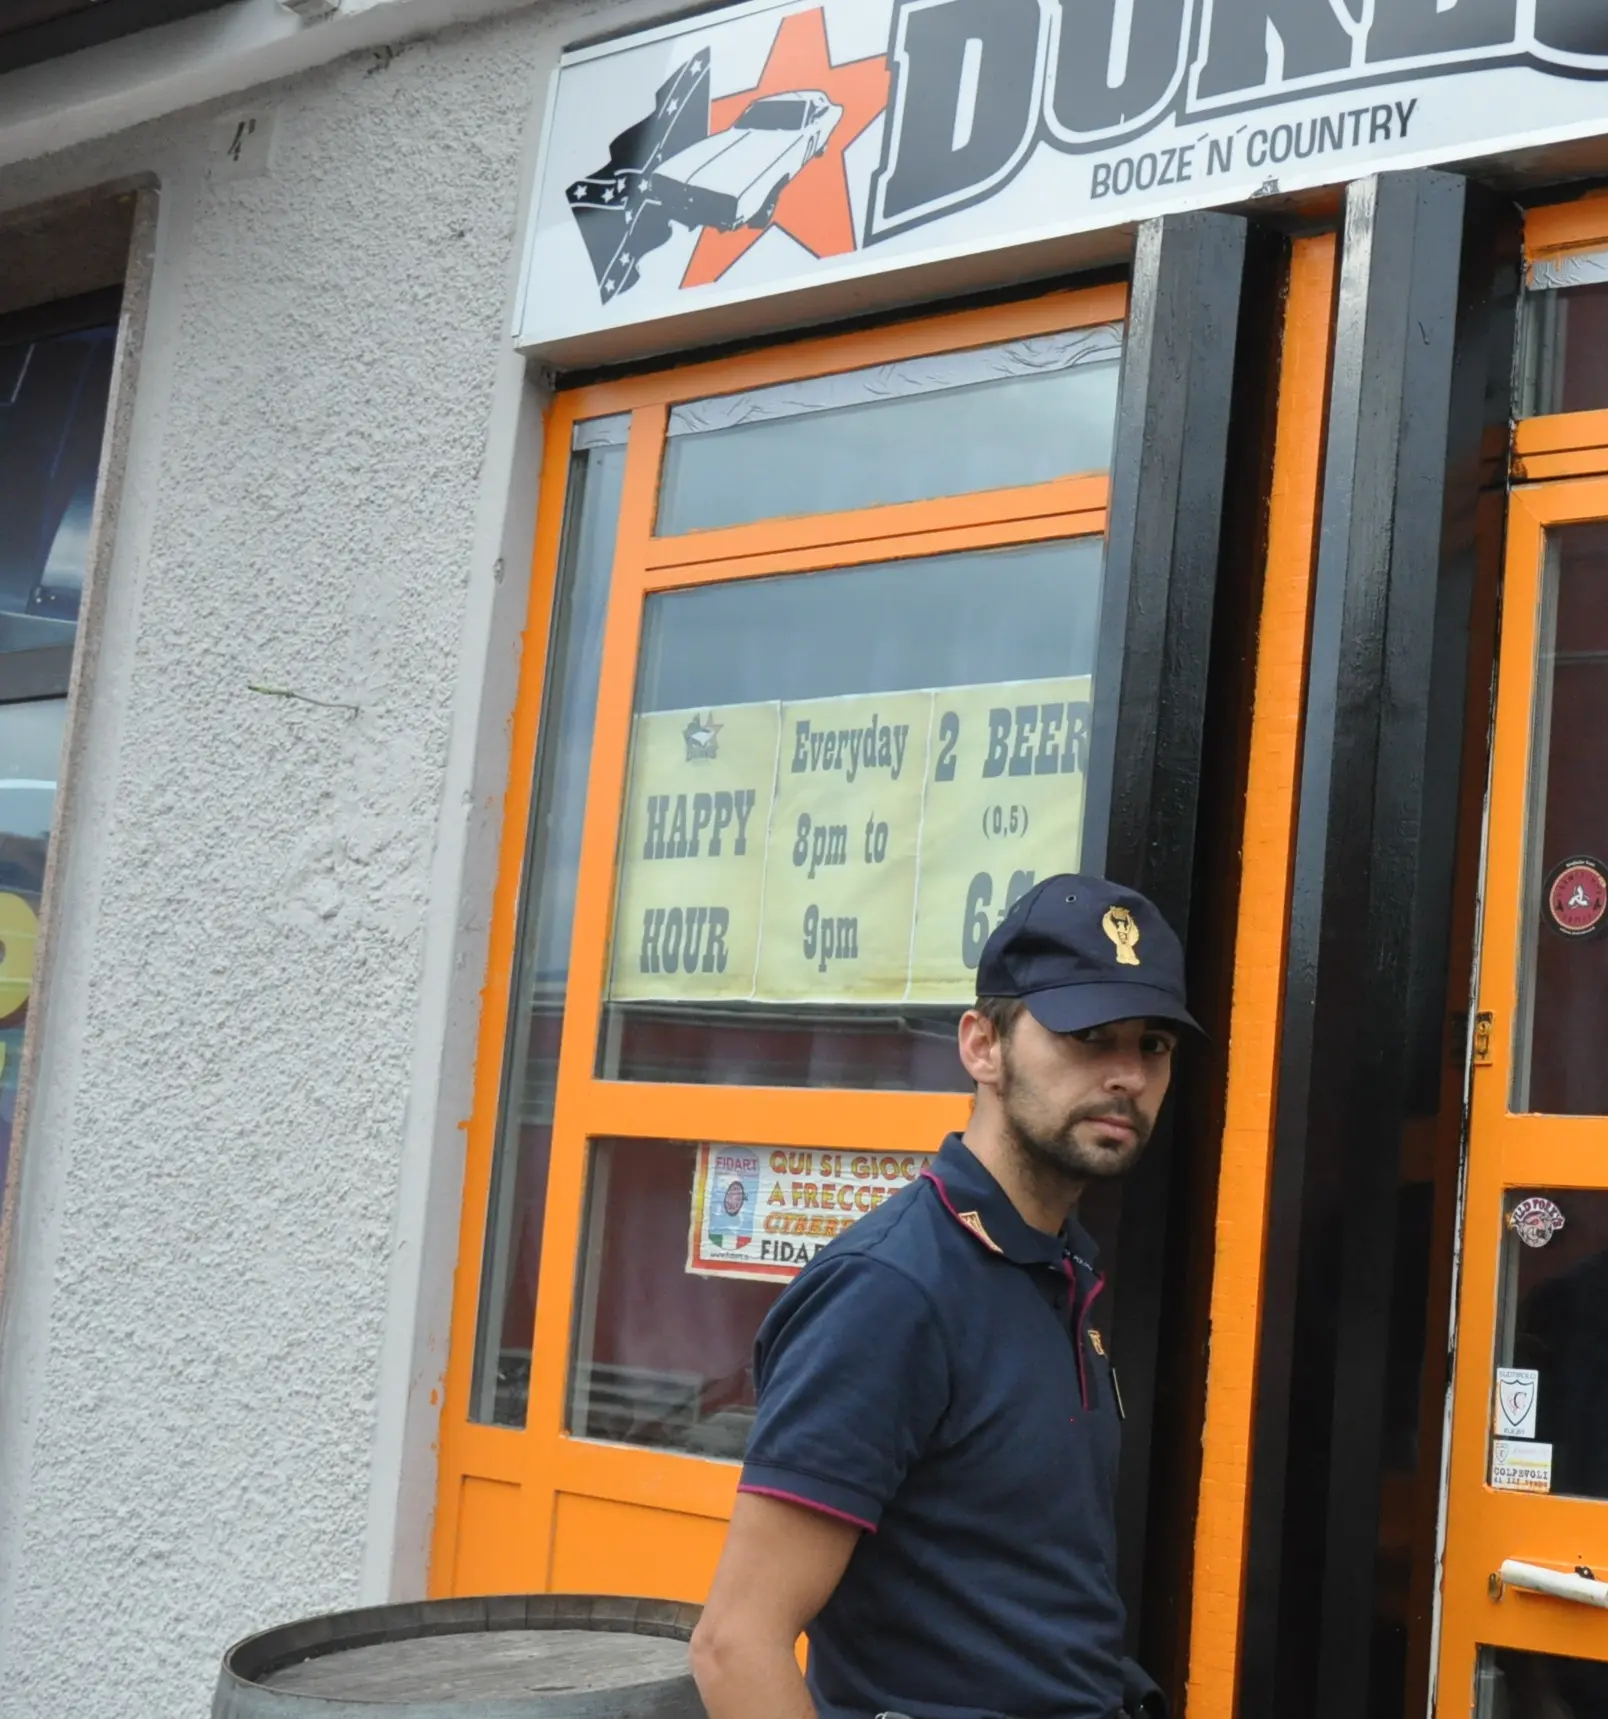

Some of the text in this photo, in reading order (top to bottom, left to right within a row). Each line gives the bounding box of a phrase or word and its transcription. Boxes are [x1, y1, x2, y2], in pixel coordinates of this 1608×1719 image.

[1090, 144, 1195, 200] BOOZE
[1246, 98, 1418, 167] COUNTRY
[791, 713, 909, 783] Everyday
[934, 711, 960, 782] 2
[643, 789, 756, 860] HAPPY
[792, 811, 889, 879] 8pm to
[982, 805, 1029, 840] (0,5)
[639, 906, 730, 974] HOUR
[803, 904, 858, 973] 9pm
[767, 1181, 786, 1206] A
[769, 1150, 813, 1176] QUI
[819, 1153, 842, 1178] SI
